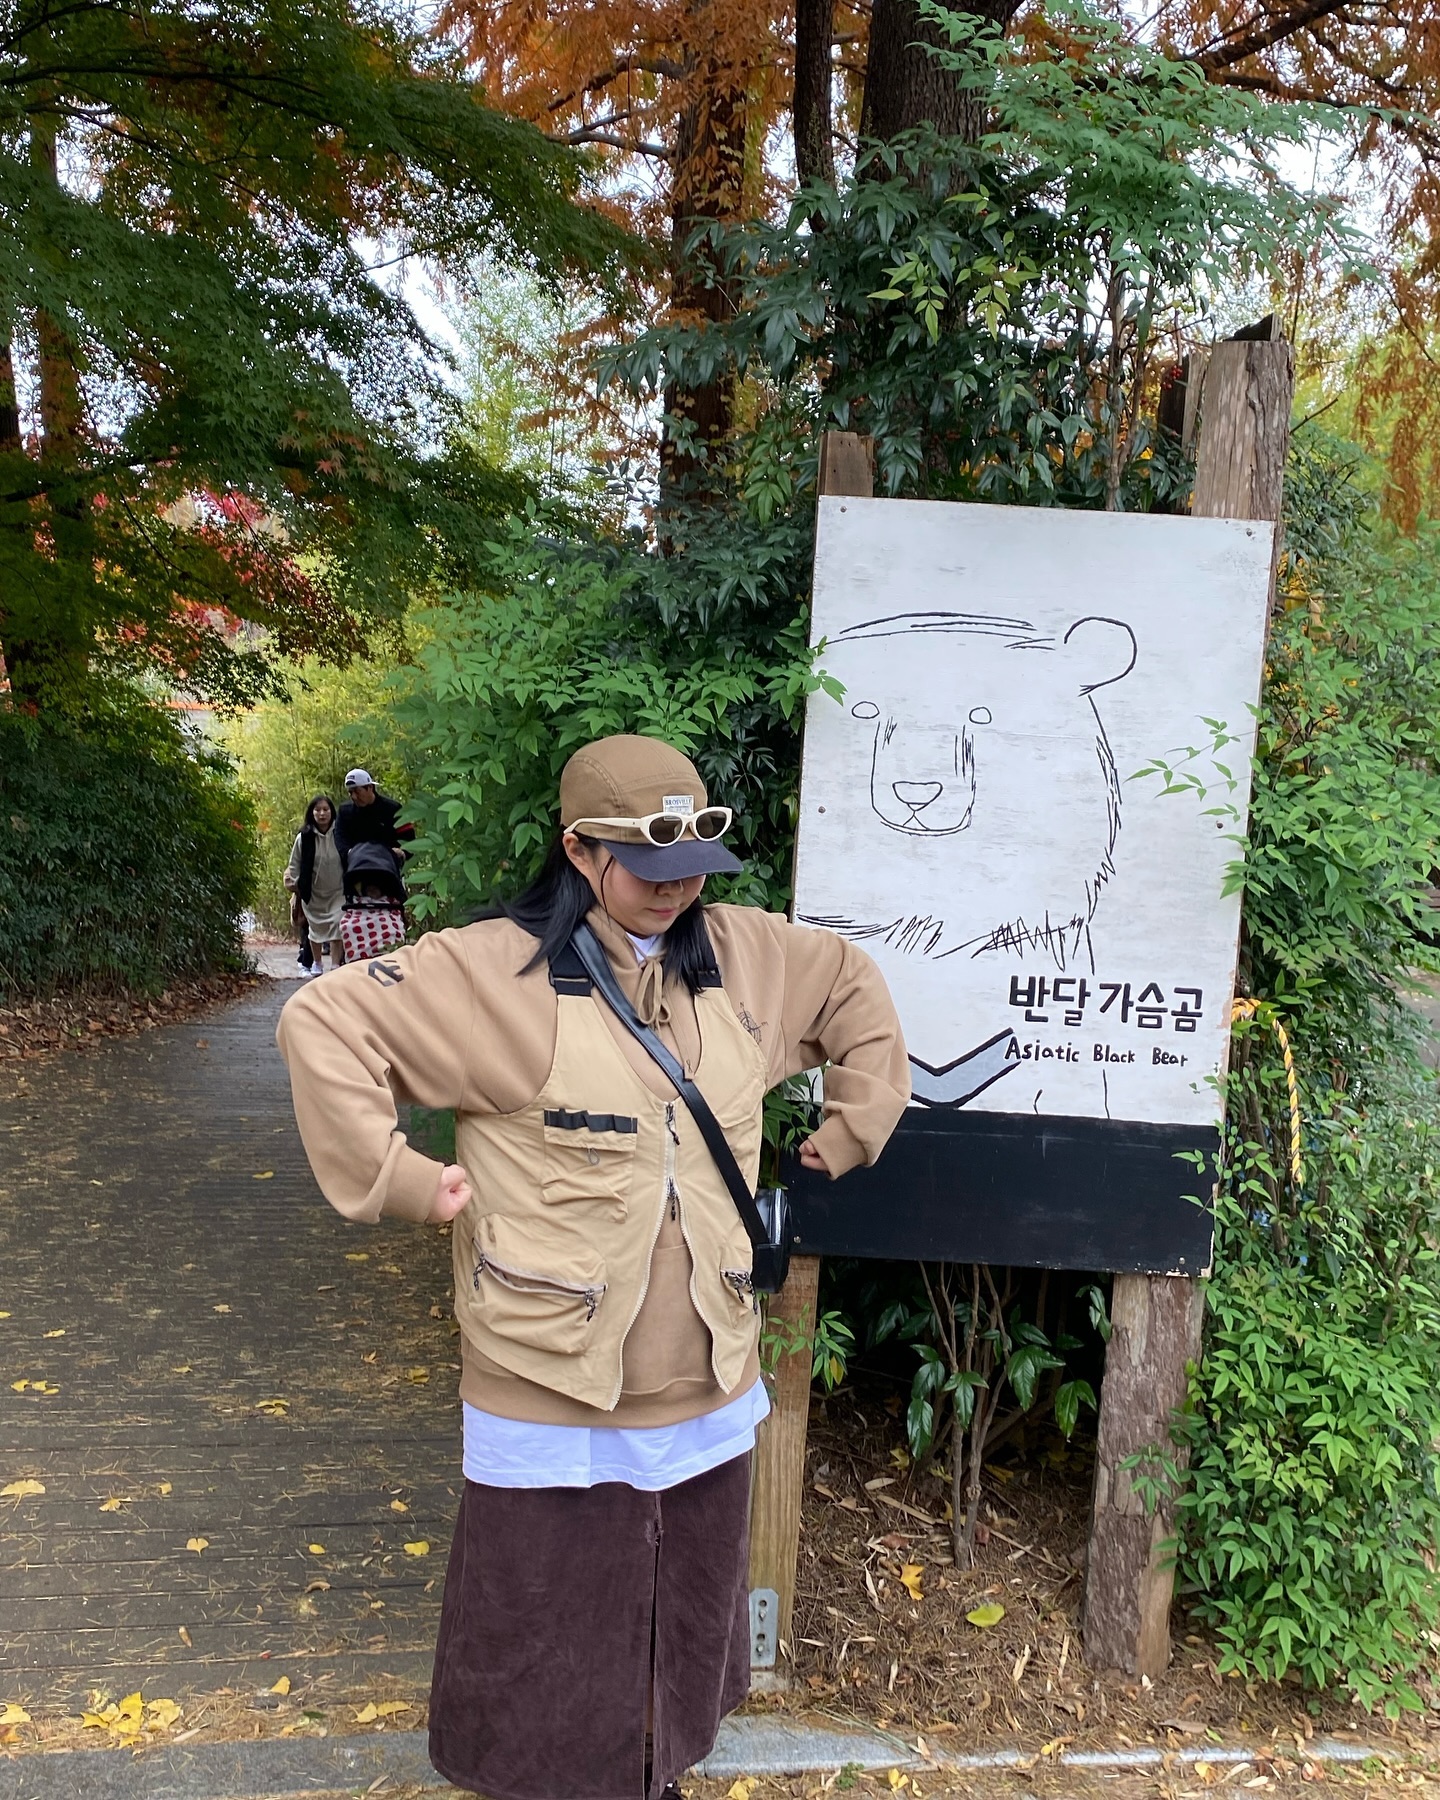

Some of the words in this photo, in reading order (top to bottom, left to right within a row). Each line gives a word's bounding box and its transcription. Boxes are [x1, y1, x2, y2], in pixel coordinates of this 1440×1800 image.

[1004, 1036, 1080, 1062] Asiatic
[1093, 1043, 1136, 1063] Black
[1152, 1047, 1189, 1067] Bear
